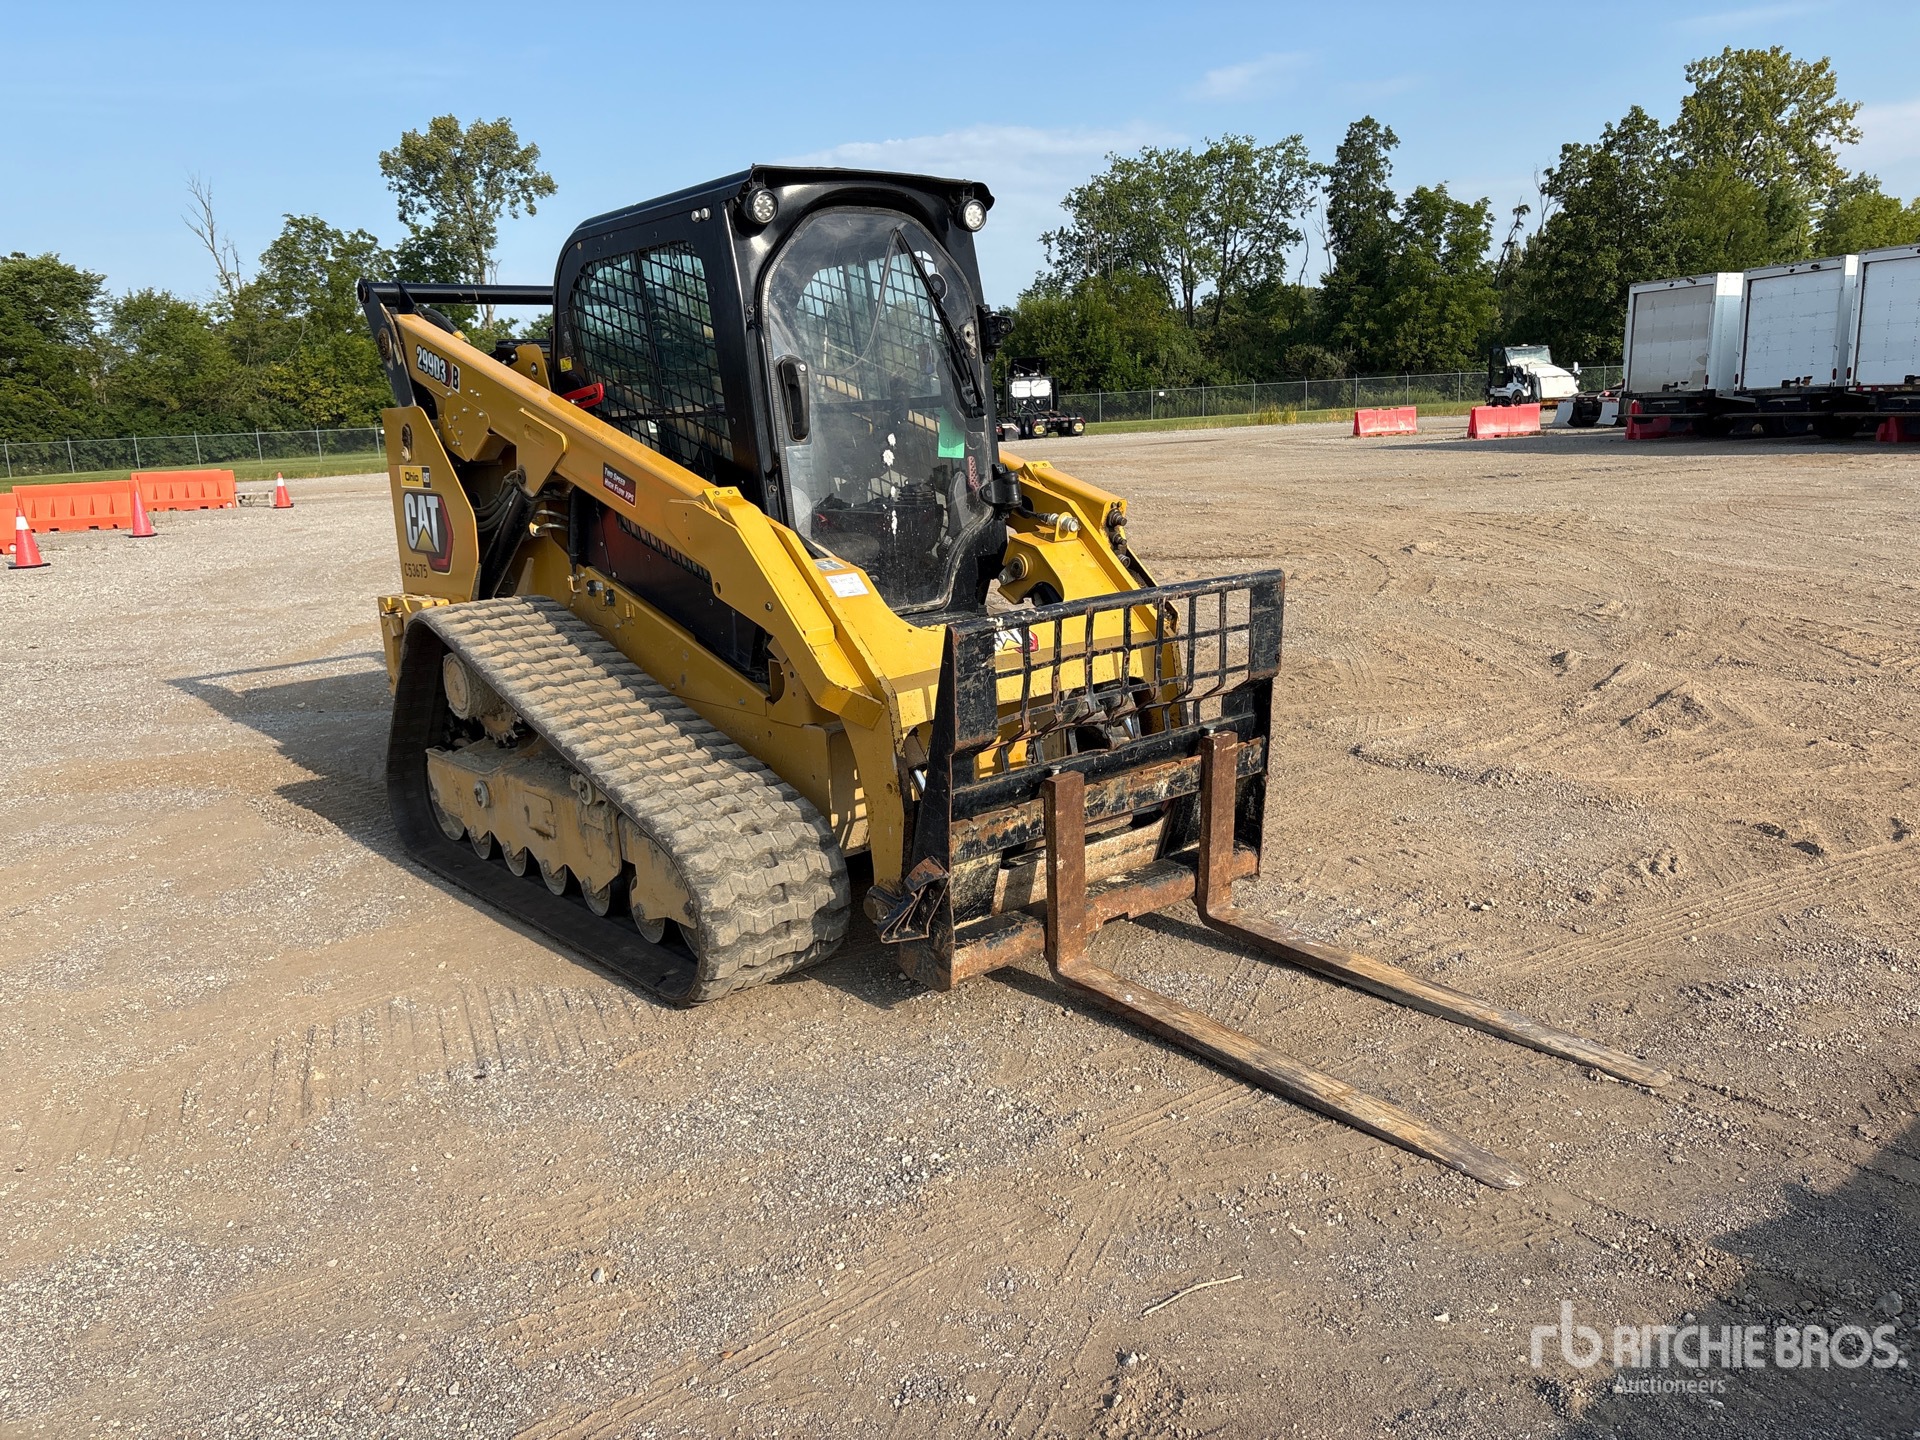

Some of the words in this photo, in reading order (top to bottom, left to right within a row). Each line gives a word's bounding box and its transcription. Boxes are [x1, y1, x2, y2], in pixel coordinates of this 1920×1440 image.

[416, 345, 447, 384] 299D3
[452, 365, 460, 390] B
[404, 471, 419, 482] Ohio
[404, 493, 440, 553] CAT
[404, 562, 428, 579] C53675
